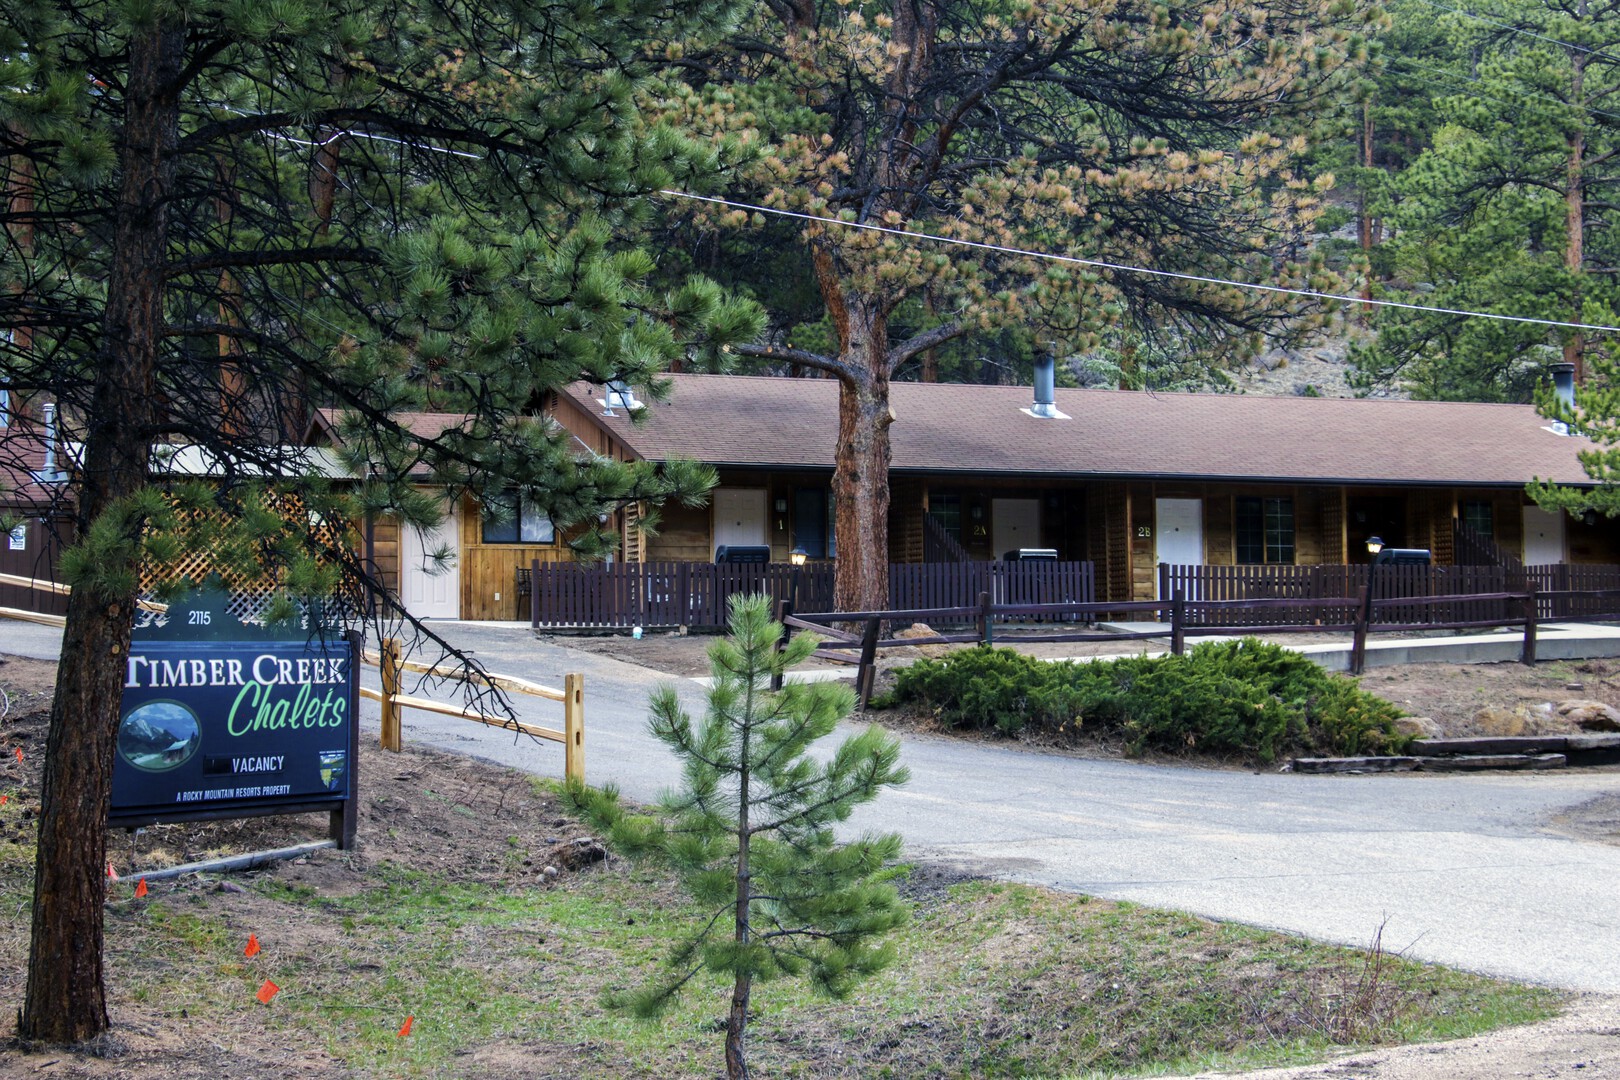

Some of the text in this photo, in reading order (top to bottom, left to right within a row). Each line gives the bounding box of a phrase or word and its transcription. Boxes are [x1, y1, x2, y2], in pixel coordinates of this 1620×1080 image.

[778, 520, 784, 530] 1
[974, 525, 987, 535] 2A
[1138, 527, 1151, 537] 2B
[188, 610, 211, 625] 2115
[125, 654, 346, 688] TIMBER CREEK
[227, 679, 346, 737] Chalets
[232, 755, 285, 773] VACANCY
[176, 784, 291, 802] A ROCKY MOUNTAIN RESORTS PROPERTY
